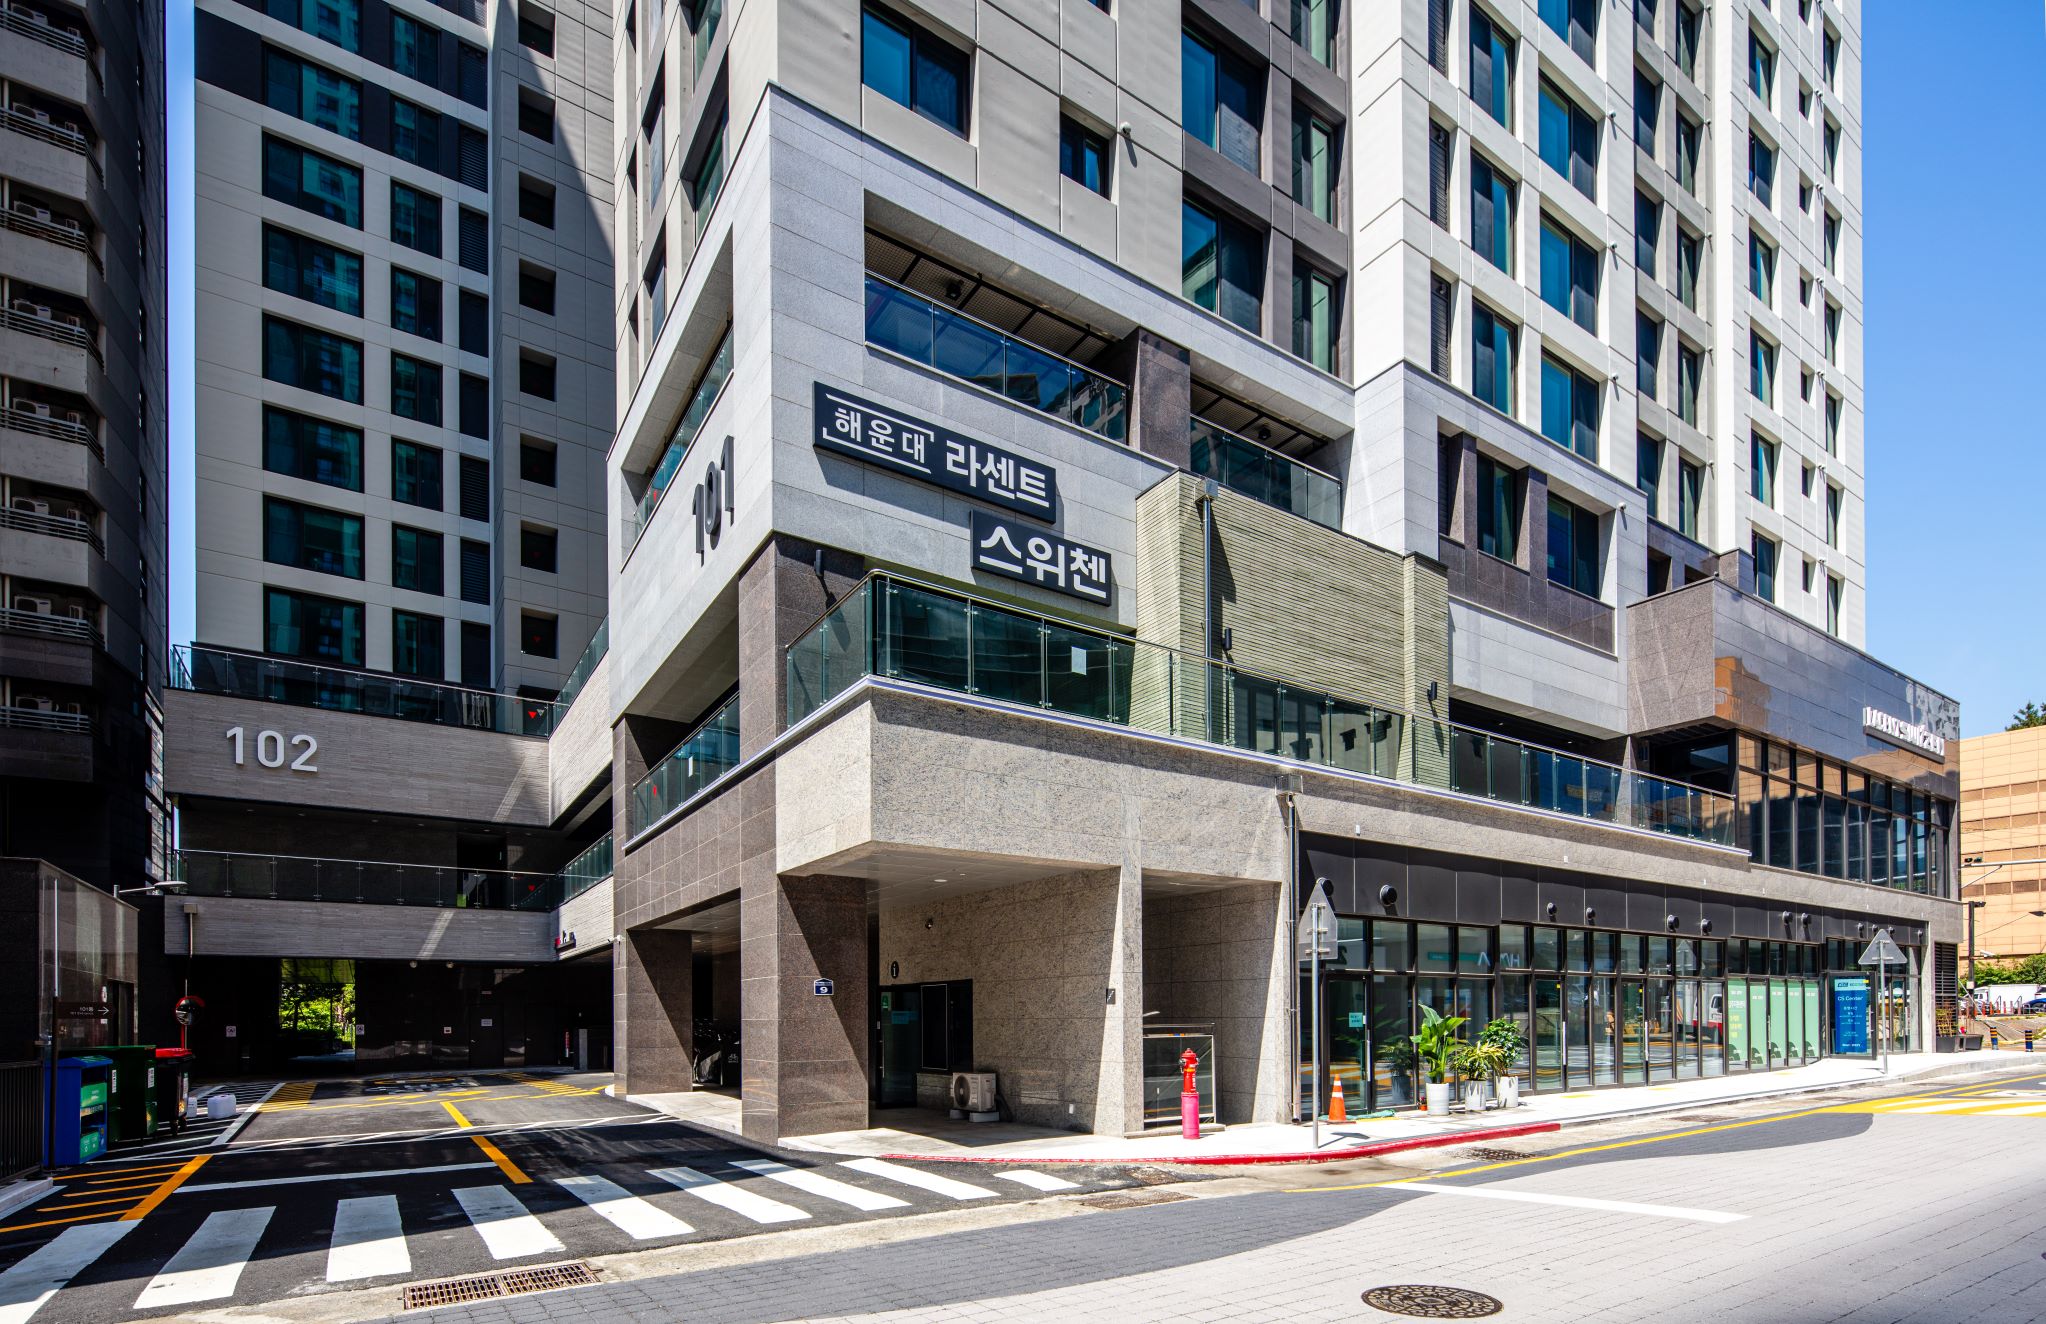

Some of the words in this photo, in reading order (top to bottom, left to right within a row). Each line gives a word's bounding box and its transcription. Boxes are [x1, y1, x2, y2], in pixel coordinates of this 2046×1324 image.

[692, 434, 735, 554] 101
[834, 407, 926, 464] 해운대
[945, 439, 1050, 509] 라센트
[979, 525, 1107, 599] 스위첸
[216, 726, 318, 772] 102
[820, 986, 828, 994] 9
